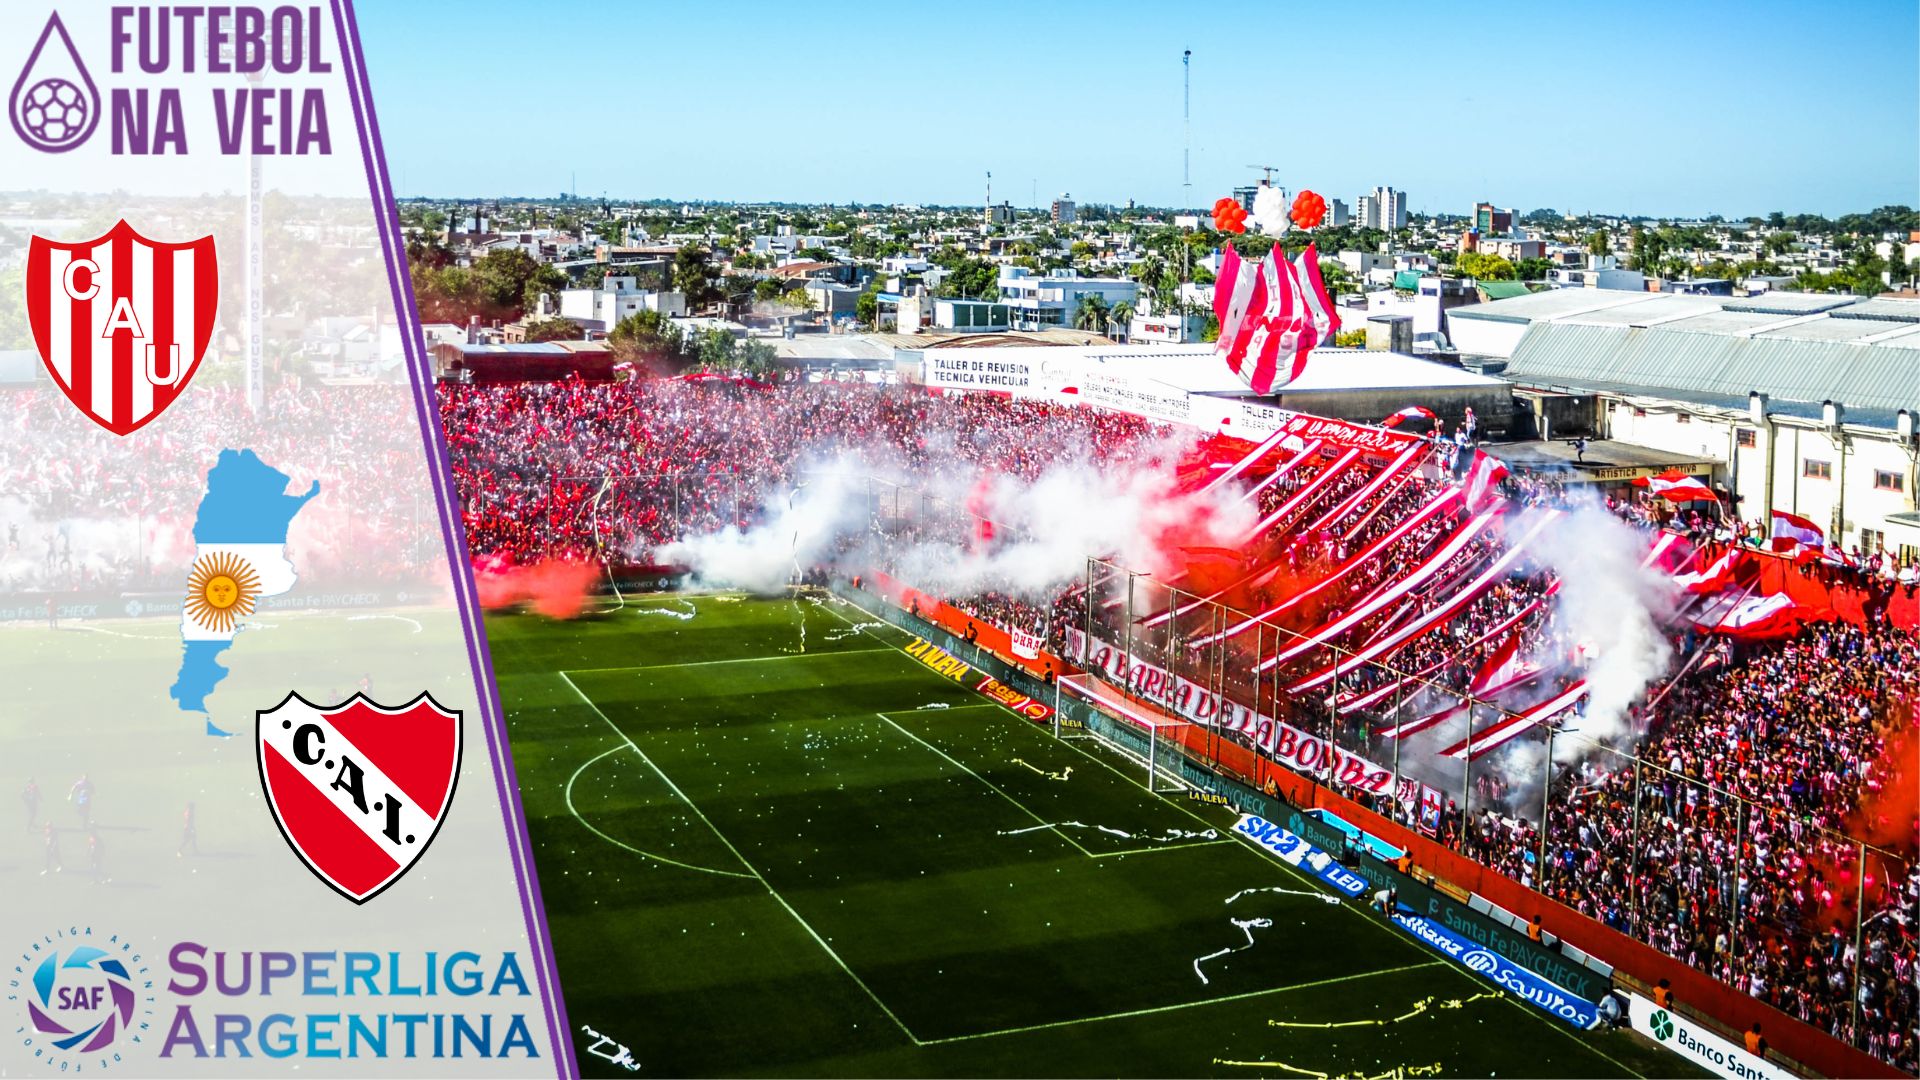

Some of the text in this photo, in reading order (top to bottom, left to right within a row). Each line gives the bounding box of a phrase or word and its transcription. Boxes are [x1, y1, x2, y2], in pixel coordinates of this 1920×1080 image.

[251, 167, 260, 226] SOMOS
[251, 290, 260, 322] NOS
[251, 335, 260, 391] GUSTA
[935, 359, 1029, 375] TALLER DE REVISION
[935, 371, 975, 383] TECNICA
[979, 374, 1029, 387] VEHICULAR
[1241, 404, 1291, 423] TALLER DE
[1595, 467, 1637, 479] ARTISTICA
[146, 602, 177, 613] Banco
[269, 592, 380, 608] Santa Fe PAYCHECK
[905, 636, 969, 682] LA NUEVA
[987, 679, 1027, 704] easy
[1011, 675, 1030, 694] Santa
[1060, 718, 1083, 729] NUEVA
[1179, 758, 1205, 787] Santa
[1218, 781, 1266, 817] PAYCHECK
[1189, 790, 1228, 805] LA NUEVA
[1307, 825, 1337, 851] Banco
[1326, 867, 1364, 893] LED
[1445, 905, 1590, 998] Santa Fe PAYCHECK
[1678, 1028, 1724, 1066] Banco
